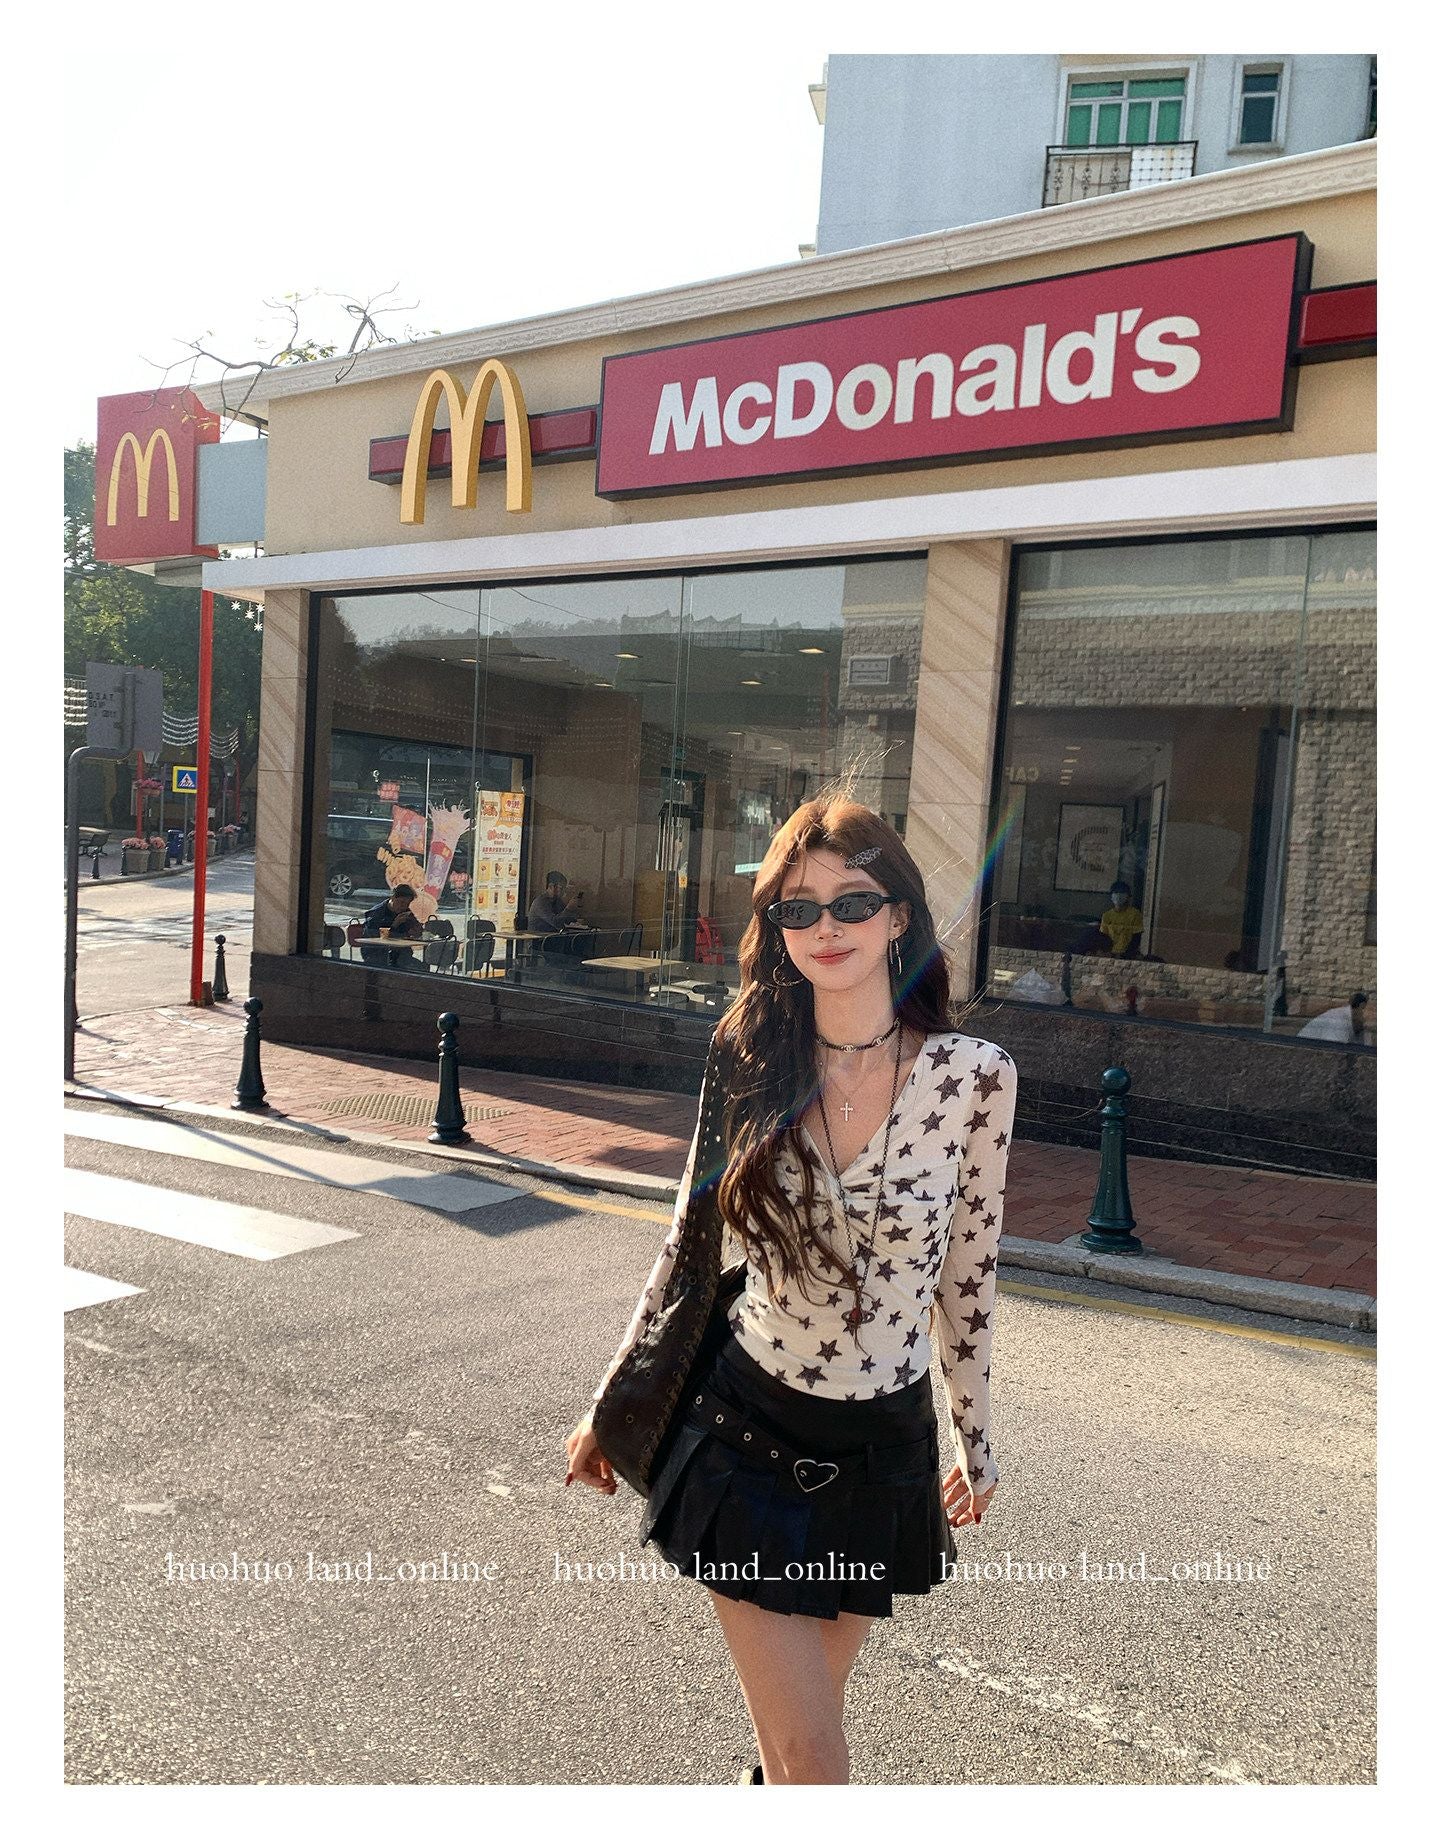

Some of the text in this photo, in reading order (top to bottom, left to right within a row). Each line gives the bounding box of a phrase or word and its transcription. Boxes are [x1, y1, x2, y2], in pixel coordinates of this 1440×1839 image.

[400, 359, 532, 526] M
[648, 307, 1201, 455] McDonald's
[107, 428, 179, 526] M
